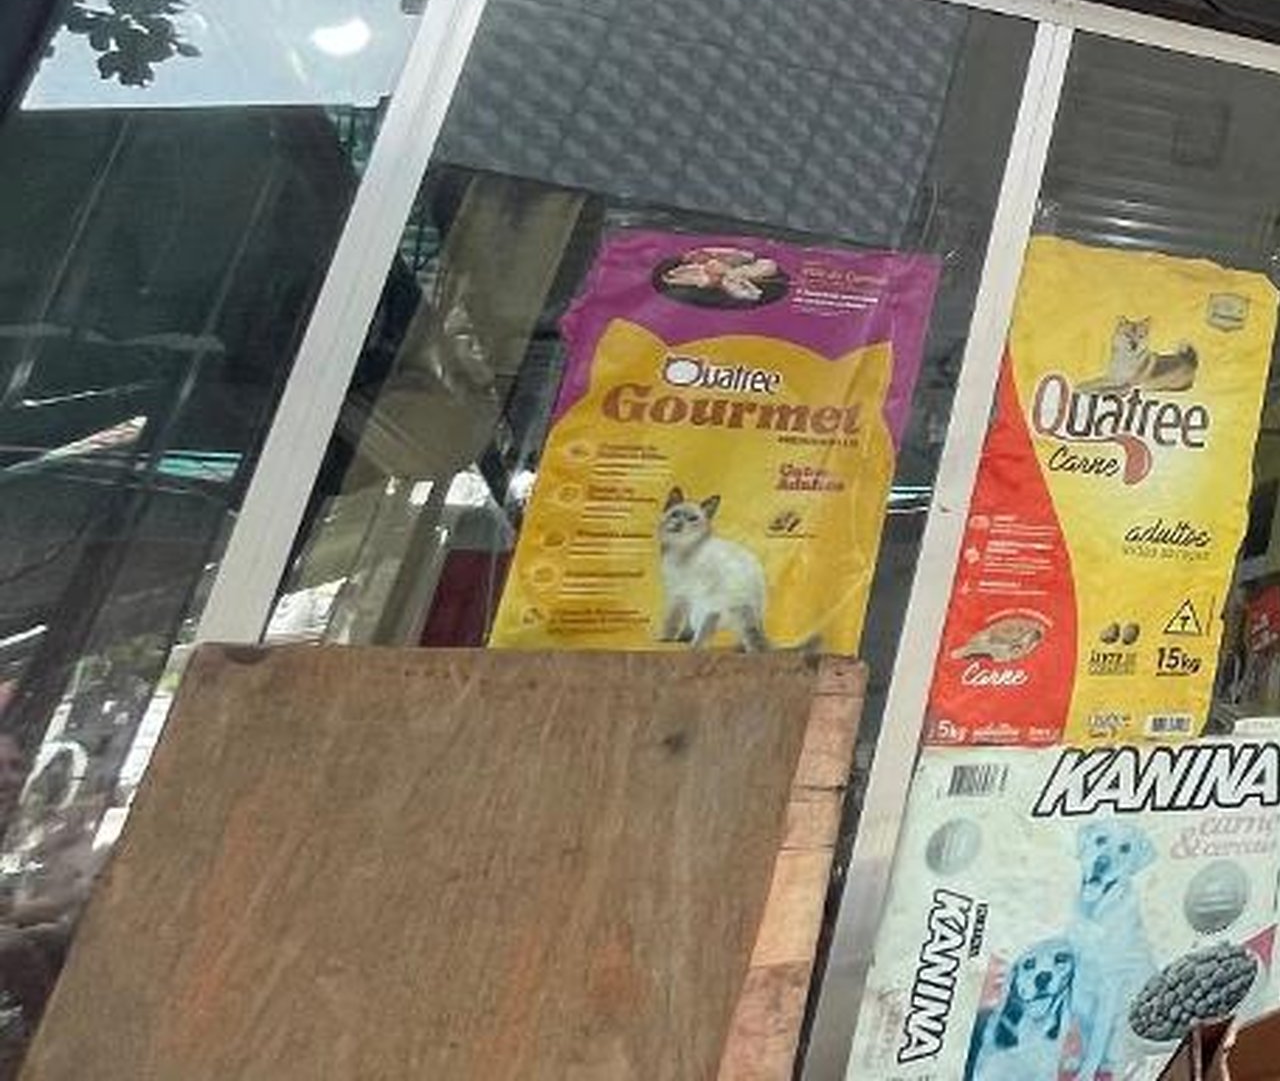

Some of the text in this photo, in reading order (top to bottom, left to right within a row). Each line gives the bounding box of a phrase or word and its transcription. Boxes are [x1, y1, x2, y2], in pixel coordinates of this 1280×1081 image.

[663, 356, 782, 395] Quatree
[602, 382, 862, 435] Gourmet
[1033, 374, 1211, 450] Quatree
[1048, 445, 1121, 477] Carne
[1124, 518, 1212, 548] adultos
[961, 662, 1029, 687] Carne
[1156, 646, 1201, 673] 15kg
[897, 888, 974, 1064] KANINA
